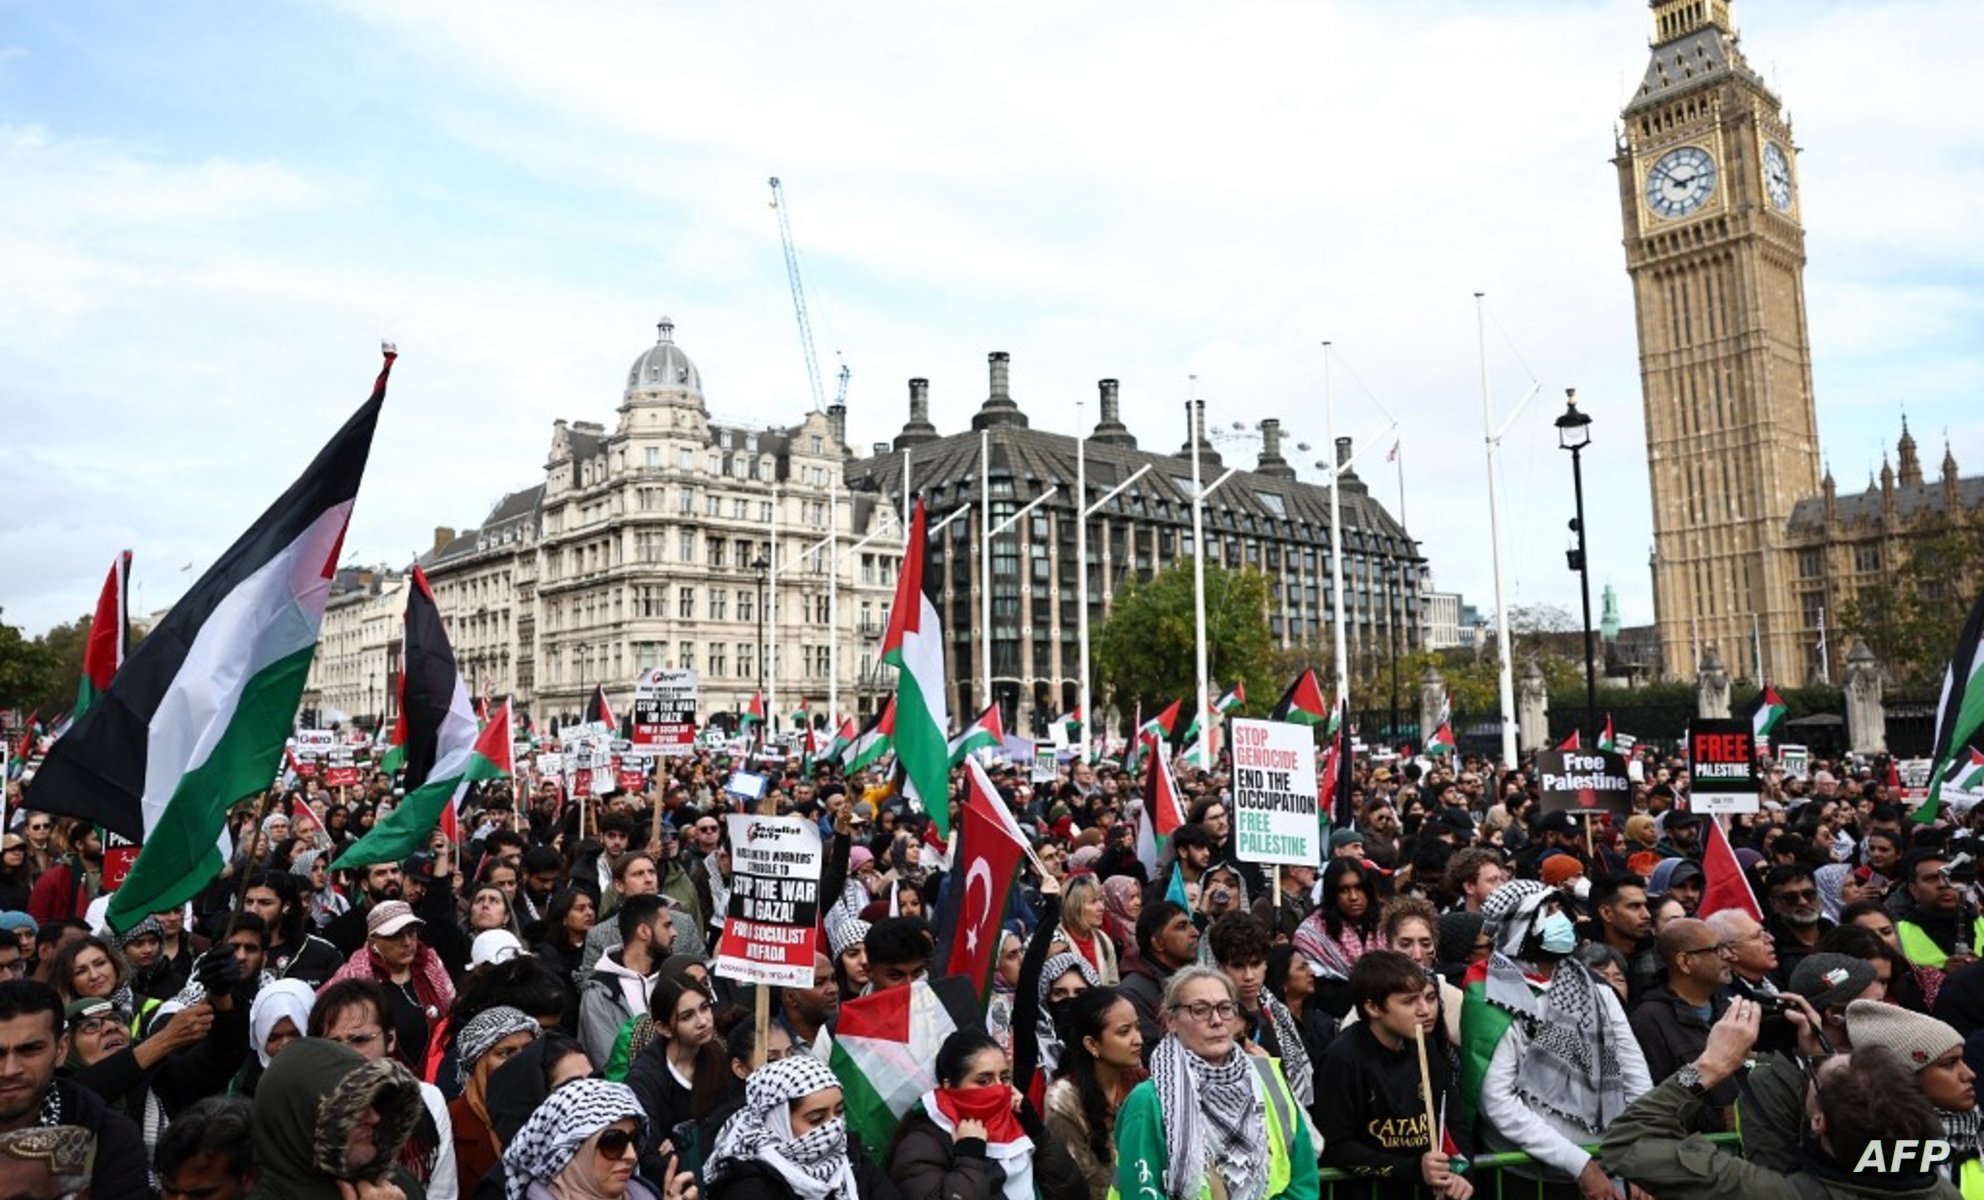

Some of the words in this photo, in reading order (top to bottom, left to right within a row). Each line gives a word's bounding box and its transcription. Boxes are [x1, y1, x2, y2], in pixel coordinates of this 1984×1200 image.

[1236, 726, 1268, 747] STOP
[1236, 747, 1298, 770] GENOCIDE
[1695, 734, 1749, 762] FREE
[1563, 753, 1605, 771] Free
[1695, 763, 1750, 777] PALESTINE
[1238, 768, 1264, 789] END
[1267, 771, 1291, 791] THE
[1542, 772, 1628, 791] Palestine
[1238, 790, 1316, 814] OCCUPATION
[755, 822, 800, 834] Socialist
[1239, 812, 1271, 832] FREE
[1240, 832, 1307, 856] PALESTINE
[754, 878, 778, 900] THE
[781, 880, 816, 903] WAR
[755, 900, 794, 923] GAZA!
[754, 925, 806, 944] SOCIALIST
